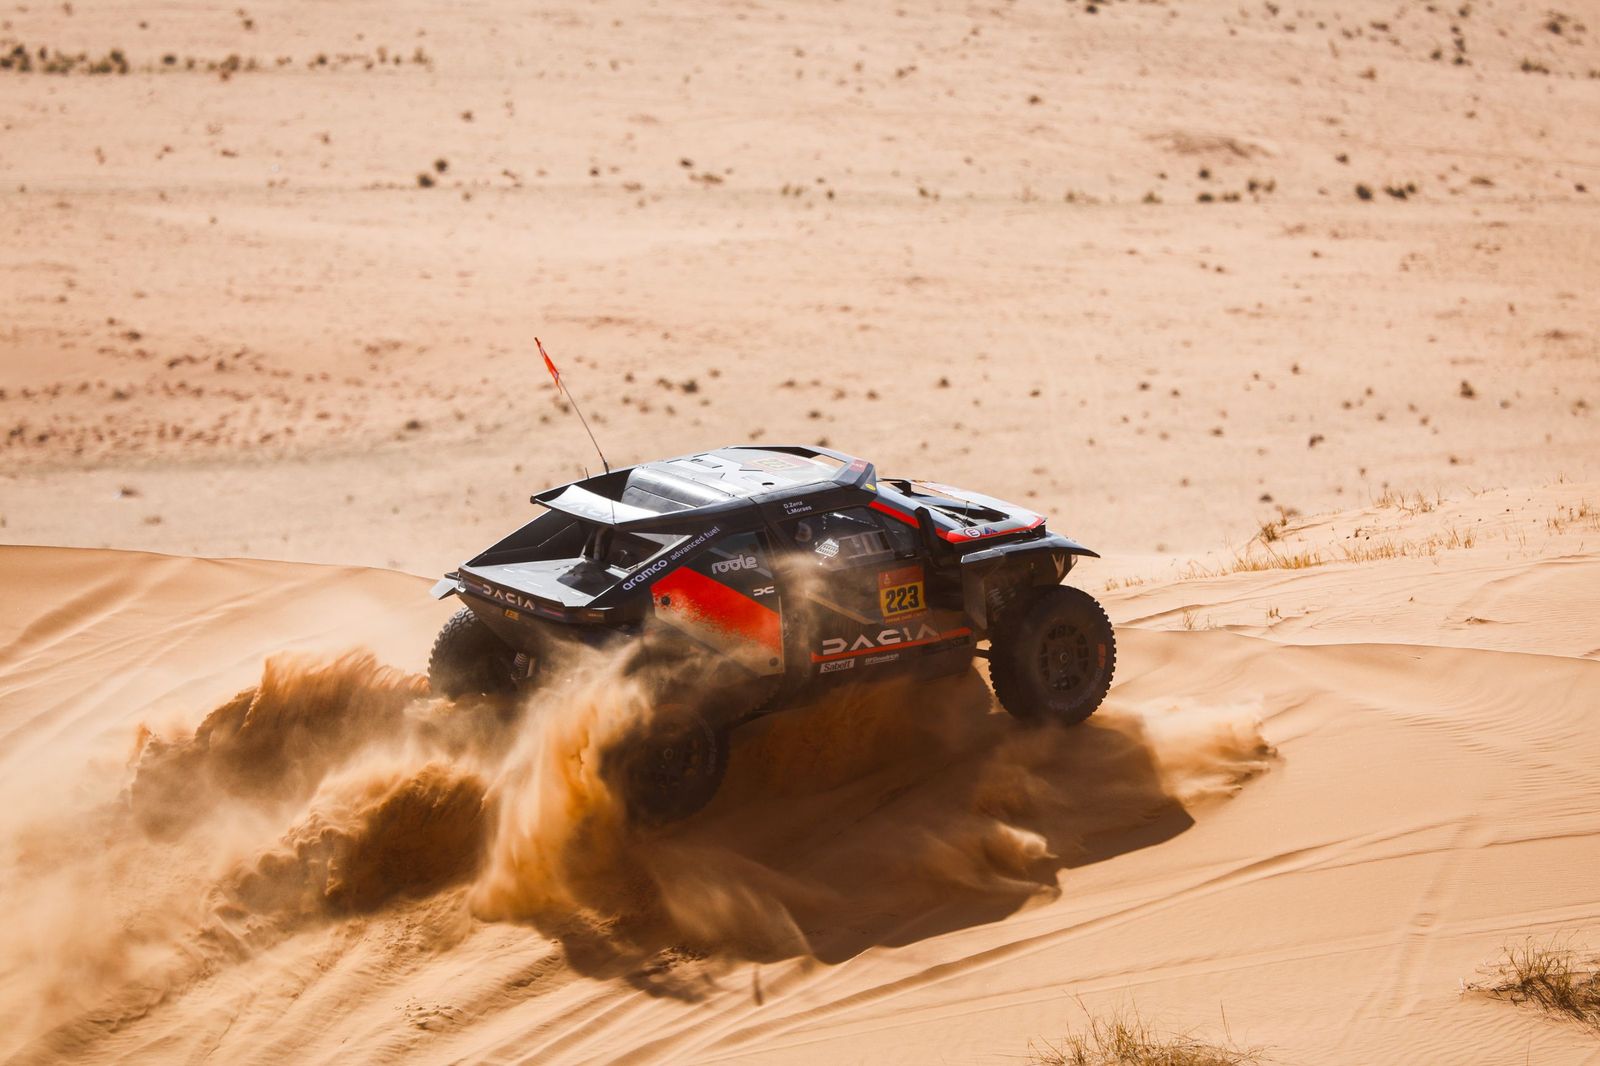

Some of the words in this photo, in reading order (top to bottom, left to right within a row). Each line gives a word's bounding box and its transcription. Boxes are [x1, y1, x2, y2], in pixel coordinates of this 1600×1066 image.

[622, 559, 668, 591] aramco
[670, 537, 706, 561] advanced
[706, 526, 720, 540] fuel
[482, 584, 535, 610] DACIA
[885, 585, 920, 613] 223
[822, 624, 941, 655] DACIA
